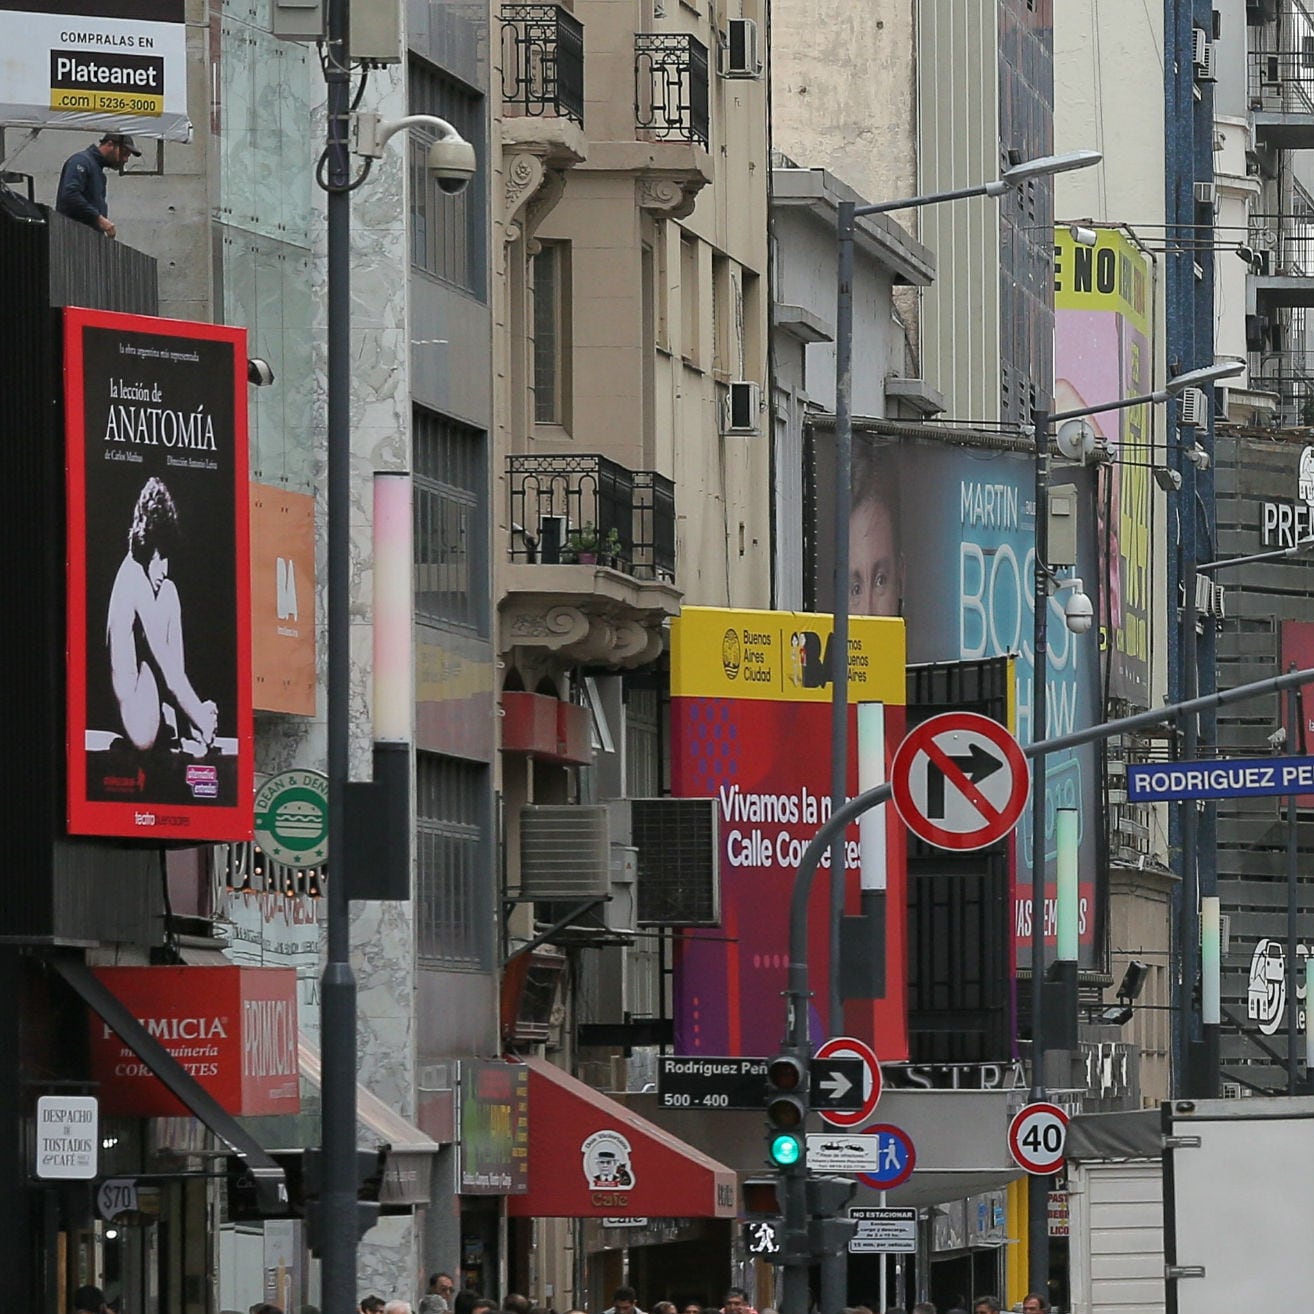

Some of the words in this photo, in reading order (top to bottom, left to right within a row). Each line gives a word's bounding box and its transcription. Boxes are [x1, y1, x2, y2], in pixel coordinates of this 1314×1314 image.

[60, 31, 135, 47] COMPRALAS
[138, 37, 154, 49] EN
[57, 57, 157, 86] Plateanet
[58, 95, 90, 107] .com
[99, 97, 156, 111] 5236-3000
[110, 377, 118, 398] la
[119, 378, 150, 401] lección
[152, 382, 162, 402] de
[104, 404, 218, 450] ANATOMÍA
[961, 480, 1018, 532] MARTIN
[743, 630, 771, 646] Buenos
[744, 649, 765, 662] Aires
[744, 667, 771, 682] Ciudad
[1308, 720, 1314, 731] la
[1134, 767, 1275, 794] RODRIGUEZ
[257, 778, 286, 809] DEAN
[288, 776, 297, 786] &
[720, 785, 799, 824] Vivamos
[802, 787, 818, 824] la
[727, 829, 772, 868] Calle
[664, 1060, 738, 1077] Rodríguez
[664, 1094, 690, 1107] 500
[703, 1094, 728, 1107] 400
[43, 1109, 92, 1124] DESPACHO
[43, 1138, 92, 1153] TOSTADOS
[1021, 1123, 1063, 1153] 40
[53, 1153, 75, 1167] CAFÉ
